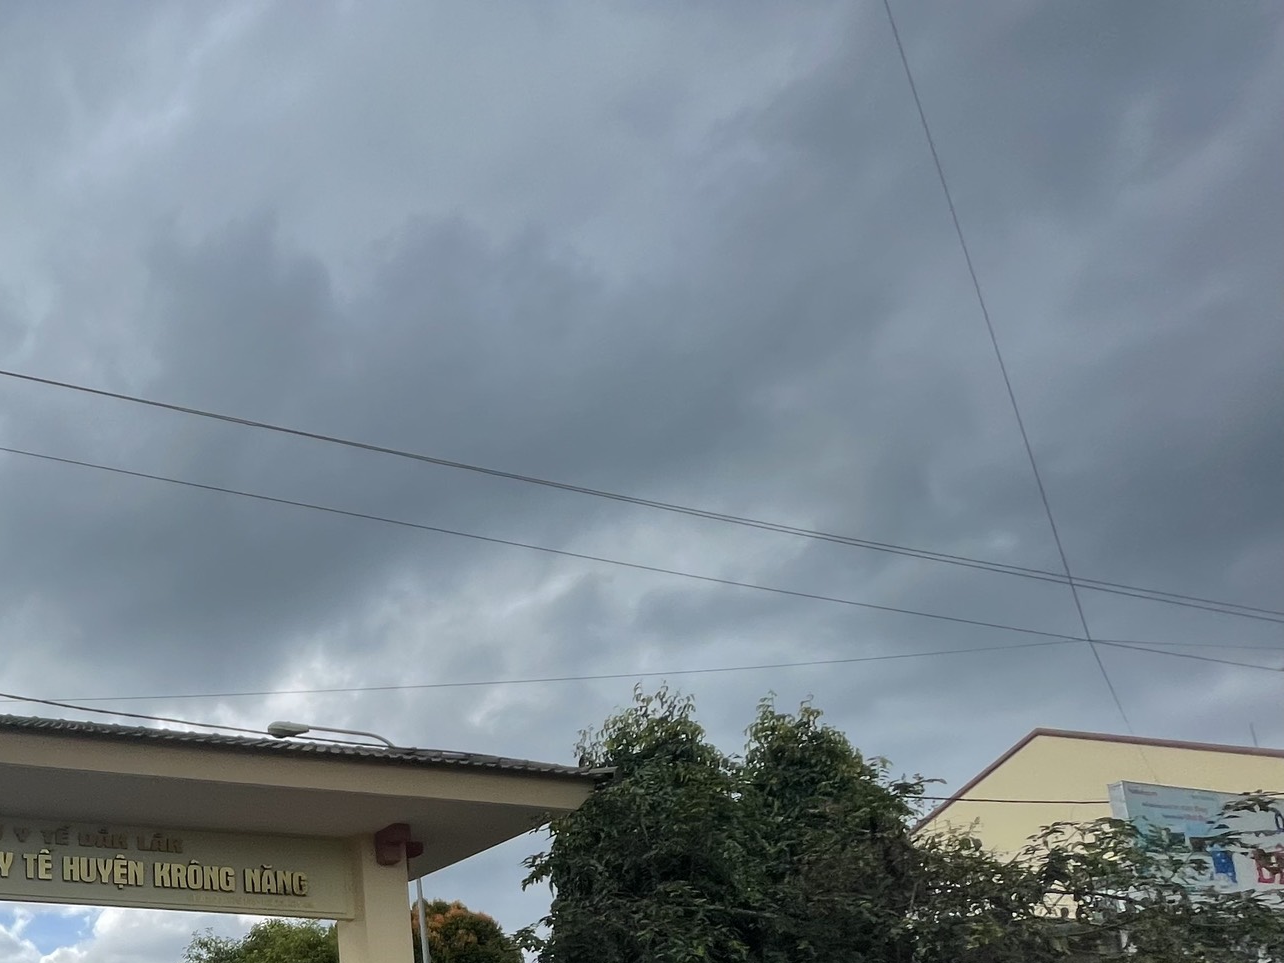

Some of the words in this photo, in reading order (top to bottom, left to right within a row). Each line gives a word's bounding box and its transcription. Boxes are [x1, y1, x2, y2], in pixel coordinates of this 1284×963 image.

[14, 826, 31, 843] Y
[62, 854, 144, 889] HUYỆN
[153, 858, 235, 892] KRÔNG
[243, 864, 309, 897] NĂNG
